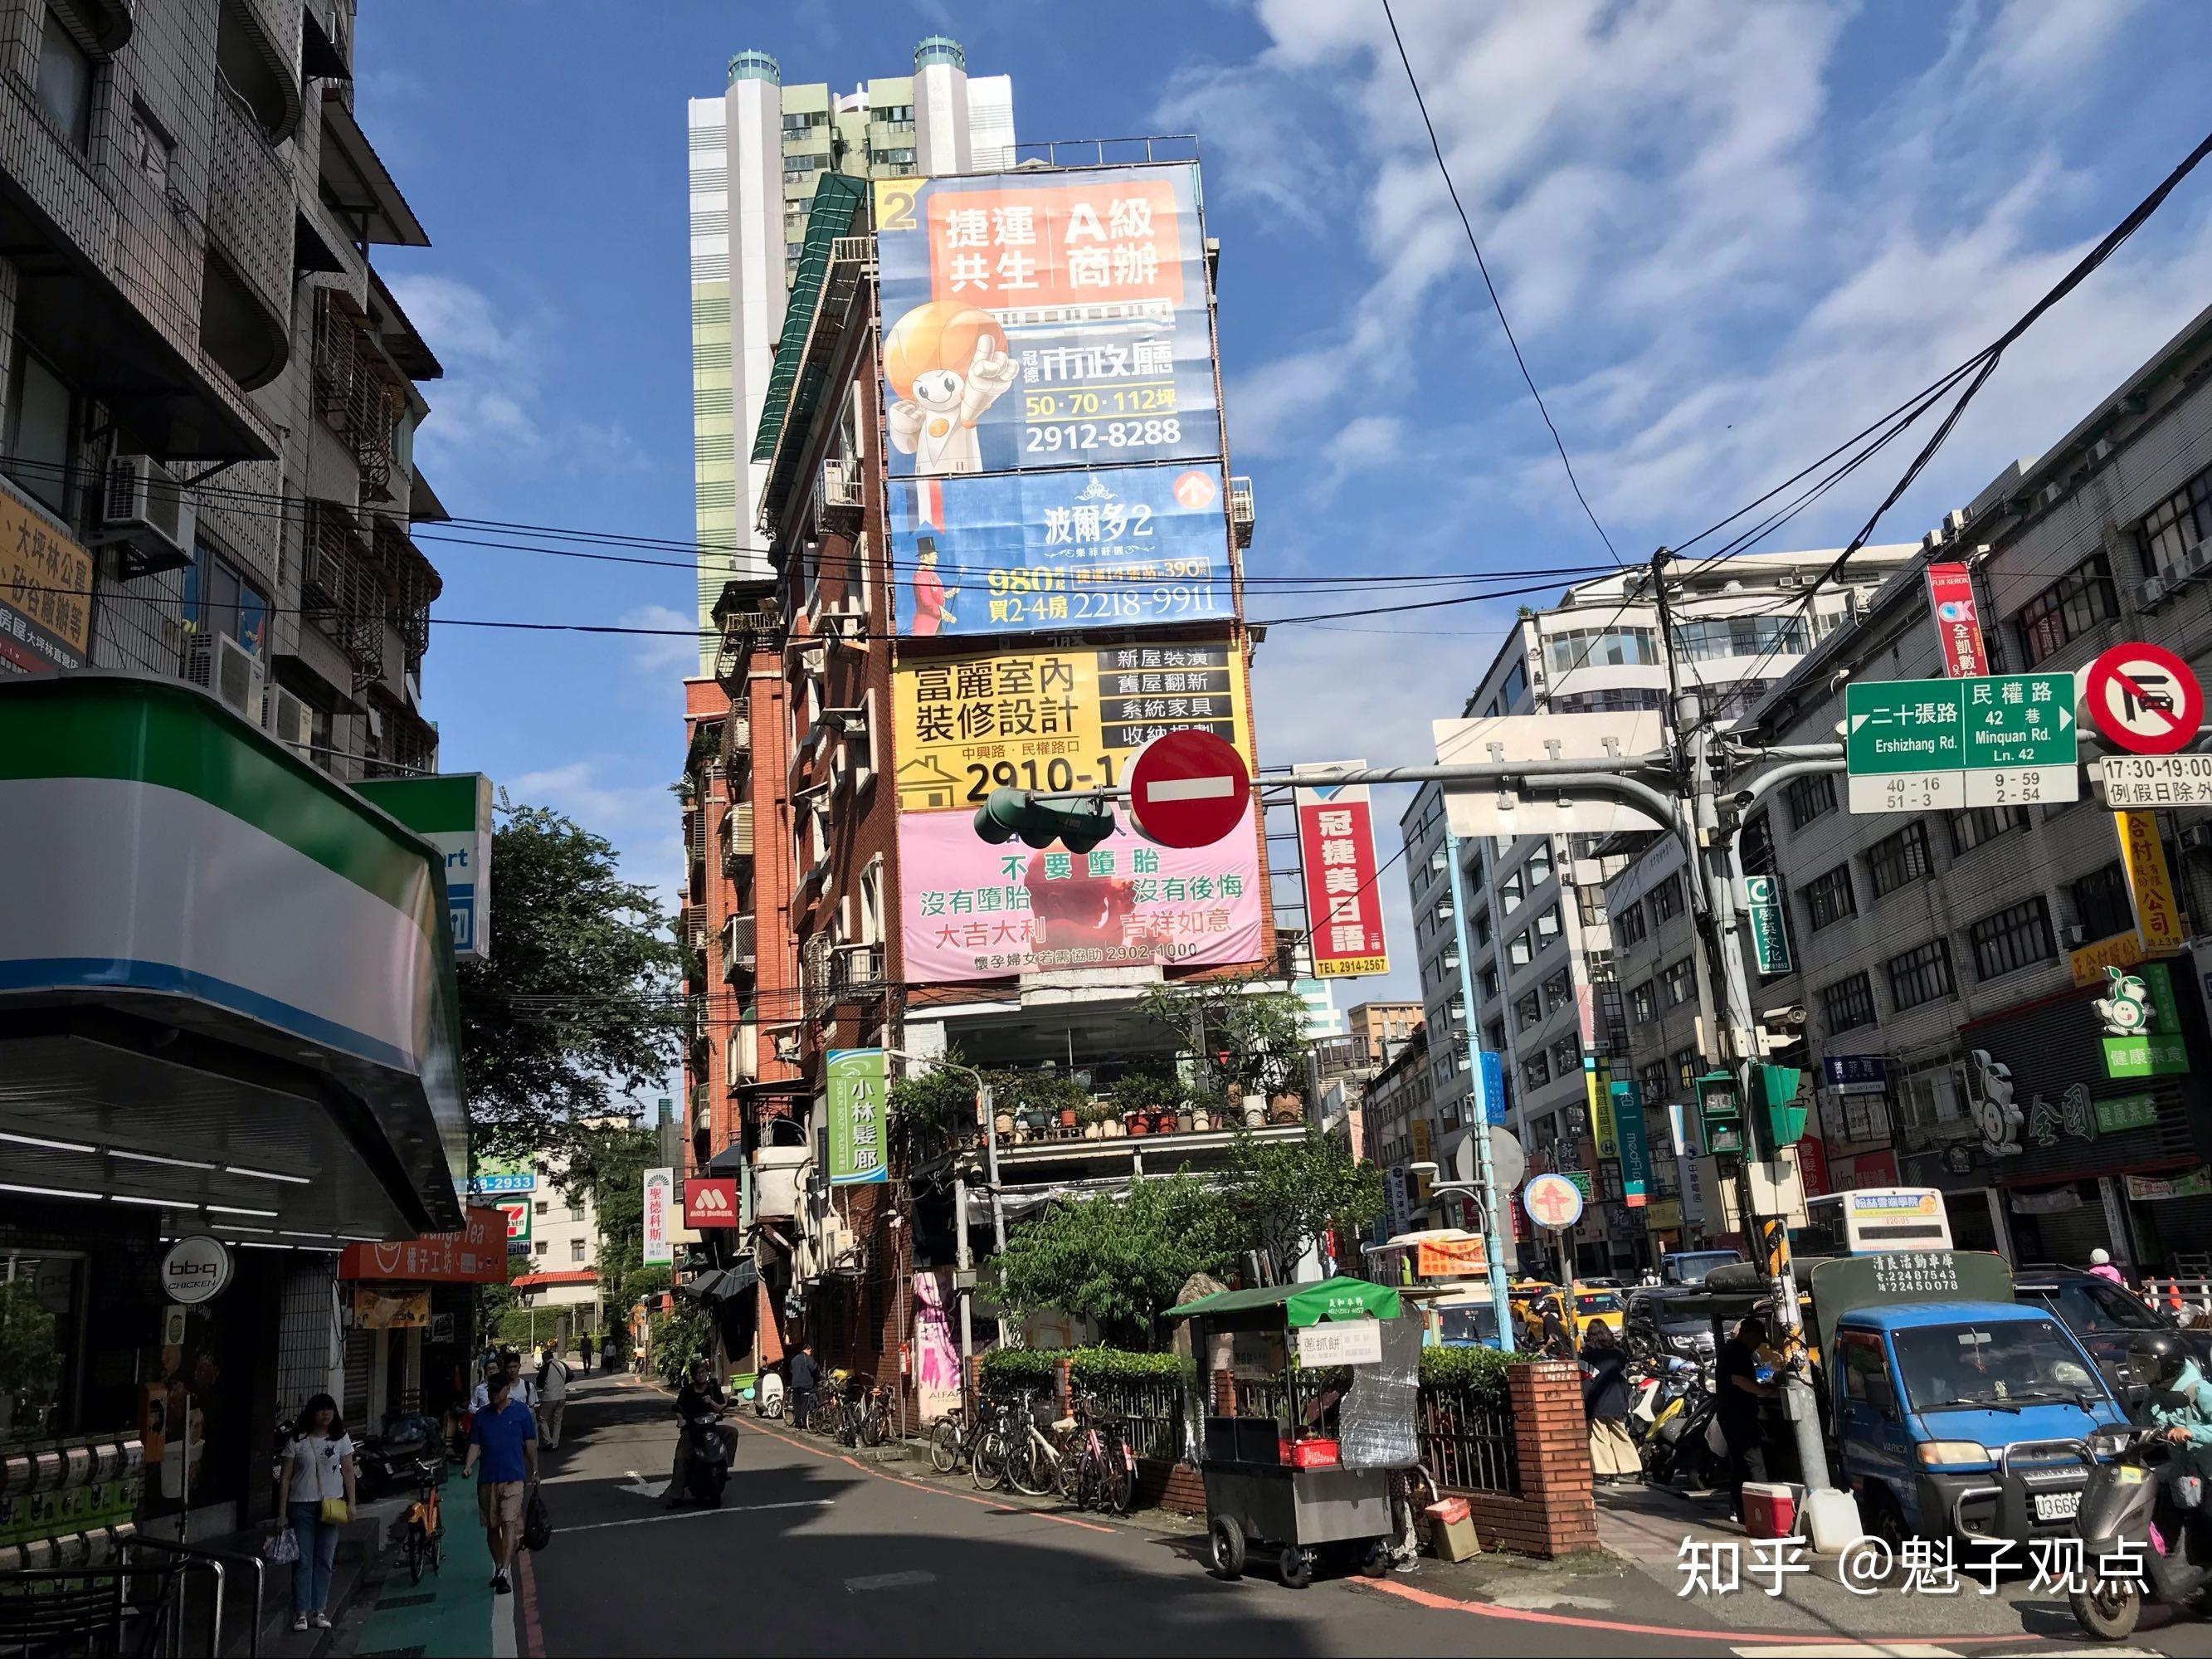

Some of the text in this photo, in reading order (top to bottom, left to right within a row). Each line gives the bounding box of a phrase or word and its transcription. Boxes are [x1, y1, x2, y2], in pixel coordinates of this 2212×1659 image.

[883, 192, 916, 230] 2
[945, 198, 1156, 249] 捷運 A級
[949, 242, 1159, 293] 共生 商辦
[1021, 349, 1040, 383] 冠德
[1040, 339, 1174, 381] 市政廳
[1026, 418, 1182, 453] 2912-8288
[1043, 504, 1153, 545] 波爾多2
[1946, 577, 1969, 585] XEROX
[989, 595, 1068, 623] 買2-4房
[1073, 585, 1215, 619] 2218-9911
[914, 657, 1074, 703] 富麗室內
[1118, 672, 1208, 693] 舊屋翻新
[1971, 681, 2053, 705] 民權路
[915, 696, 1079, 743] 裝修設計
[1122, 698, 1212, 719] 系統家具
[1871, 703, 1958, 725] 二十張路
[1985, 708, 2040, 725] 42 巷
[1875, 736, 1957, 754] Ershizhang Rd.
[1976, 728, 2051, 746] Minquan Rd.
[1994, 748, 2034, 761] Ln. 42
[2105, 759, 2212, 779] 17:30-19:00
[1001, 848, 1160, 881] 不要墮胎
[920, 874, 1243, 917] 沒有墮胎 沒有後悔
[1318, 809, 1365, 953] 冠捷美日語
[935, 908, 1231, 949] 大吉大利 吉祥如意
[1370, 932, 1381, 950] 三樓
[974, 942, 1197, 971] 懷孕婦女若需協助 2902-1000
[1319, 962, 1336, 974] TEL
[2111, 1046, 2185, 1067] 健康素食
[851, 1079, 878, 1169] 小林髮廊
[465, 1215, 485, 1244] Tea
[650, 1188, 661, 1242] 聖德科斯
[1873, 1253, 1953, 1271] 清良活動車庫
[168, 1280, 216, 1290] CHICKEN
[1883, 1442, 1907, 1455] VARICA
